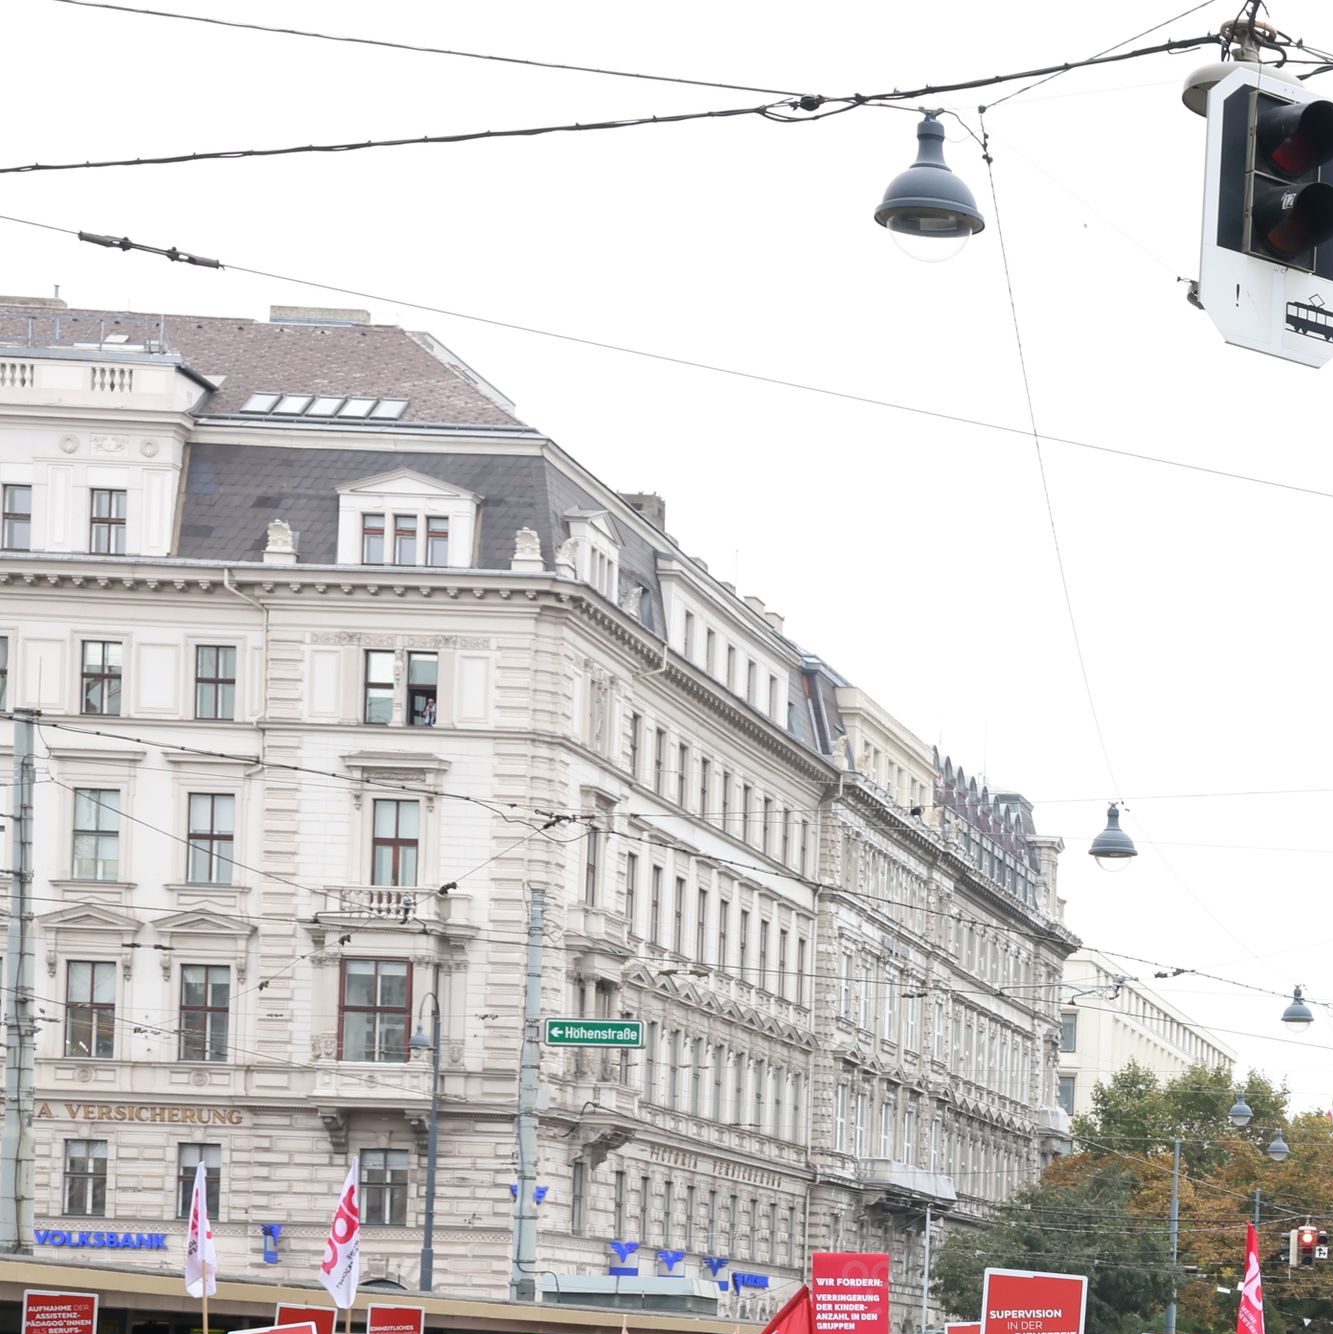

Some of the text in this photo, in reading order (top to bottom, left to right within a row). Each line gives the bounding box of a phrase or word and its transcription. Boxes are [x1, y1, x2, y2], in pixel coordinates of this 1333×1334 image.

[565, 1026, 638, 1041] Höhenstraße
[64, 1103, 244, 1125] VERSICHERUNG
[33, 1229, 169, 1250] VOLKSBANK
[816, 1278, 884, 1287] WIR FORDERN:
[816, 1294, 880, 1302] VERRINGERUNG
[816, 1303, 868, 1311] DER KINDER-
[816, 1313, 878, 1321] ANZAHL IN DEN
[989, 1309, 1062, 1319] SUPERVISION
[816, 1322, 856, 1330] GRUPPEN
[1007, 1321, 1043, 1330] IN DER
